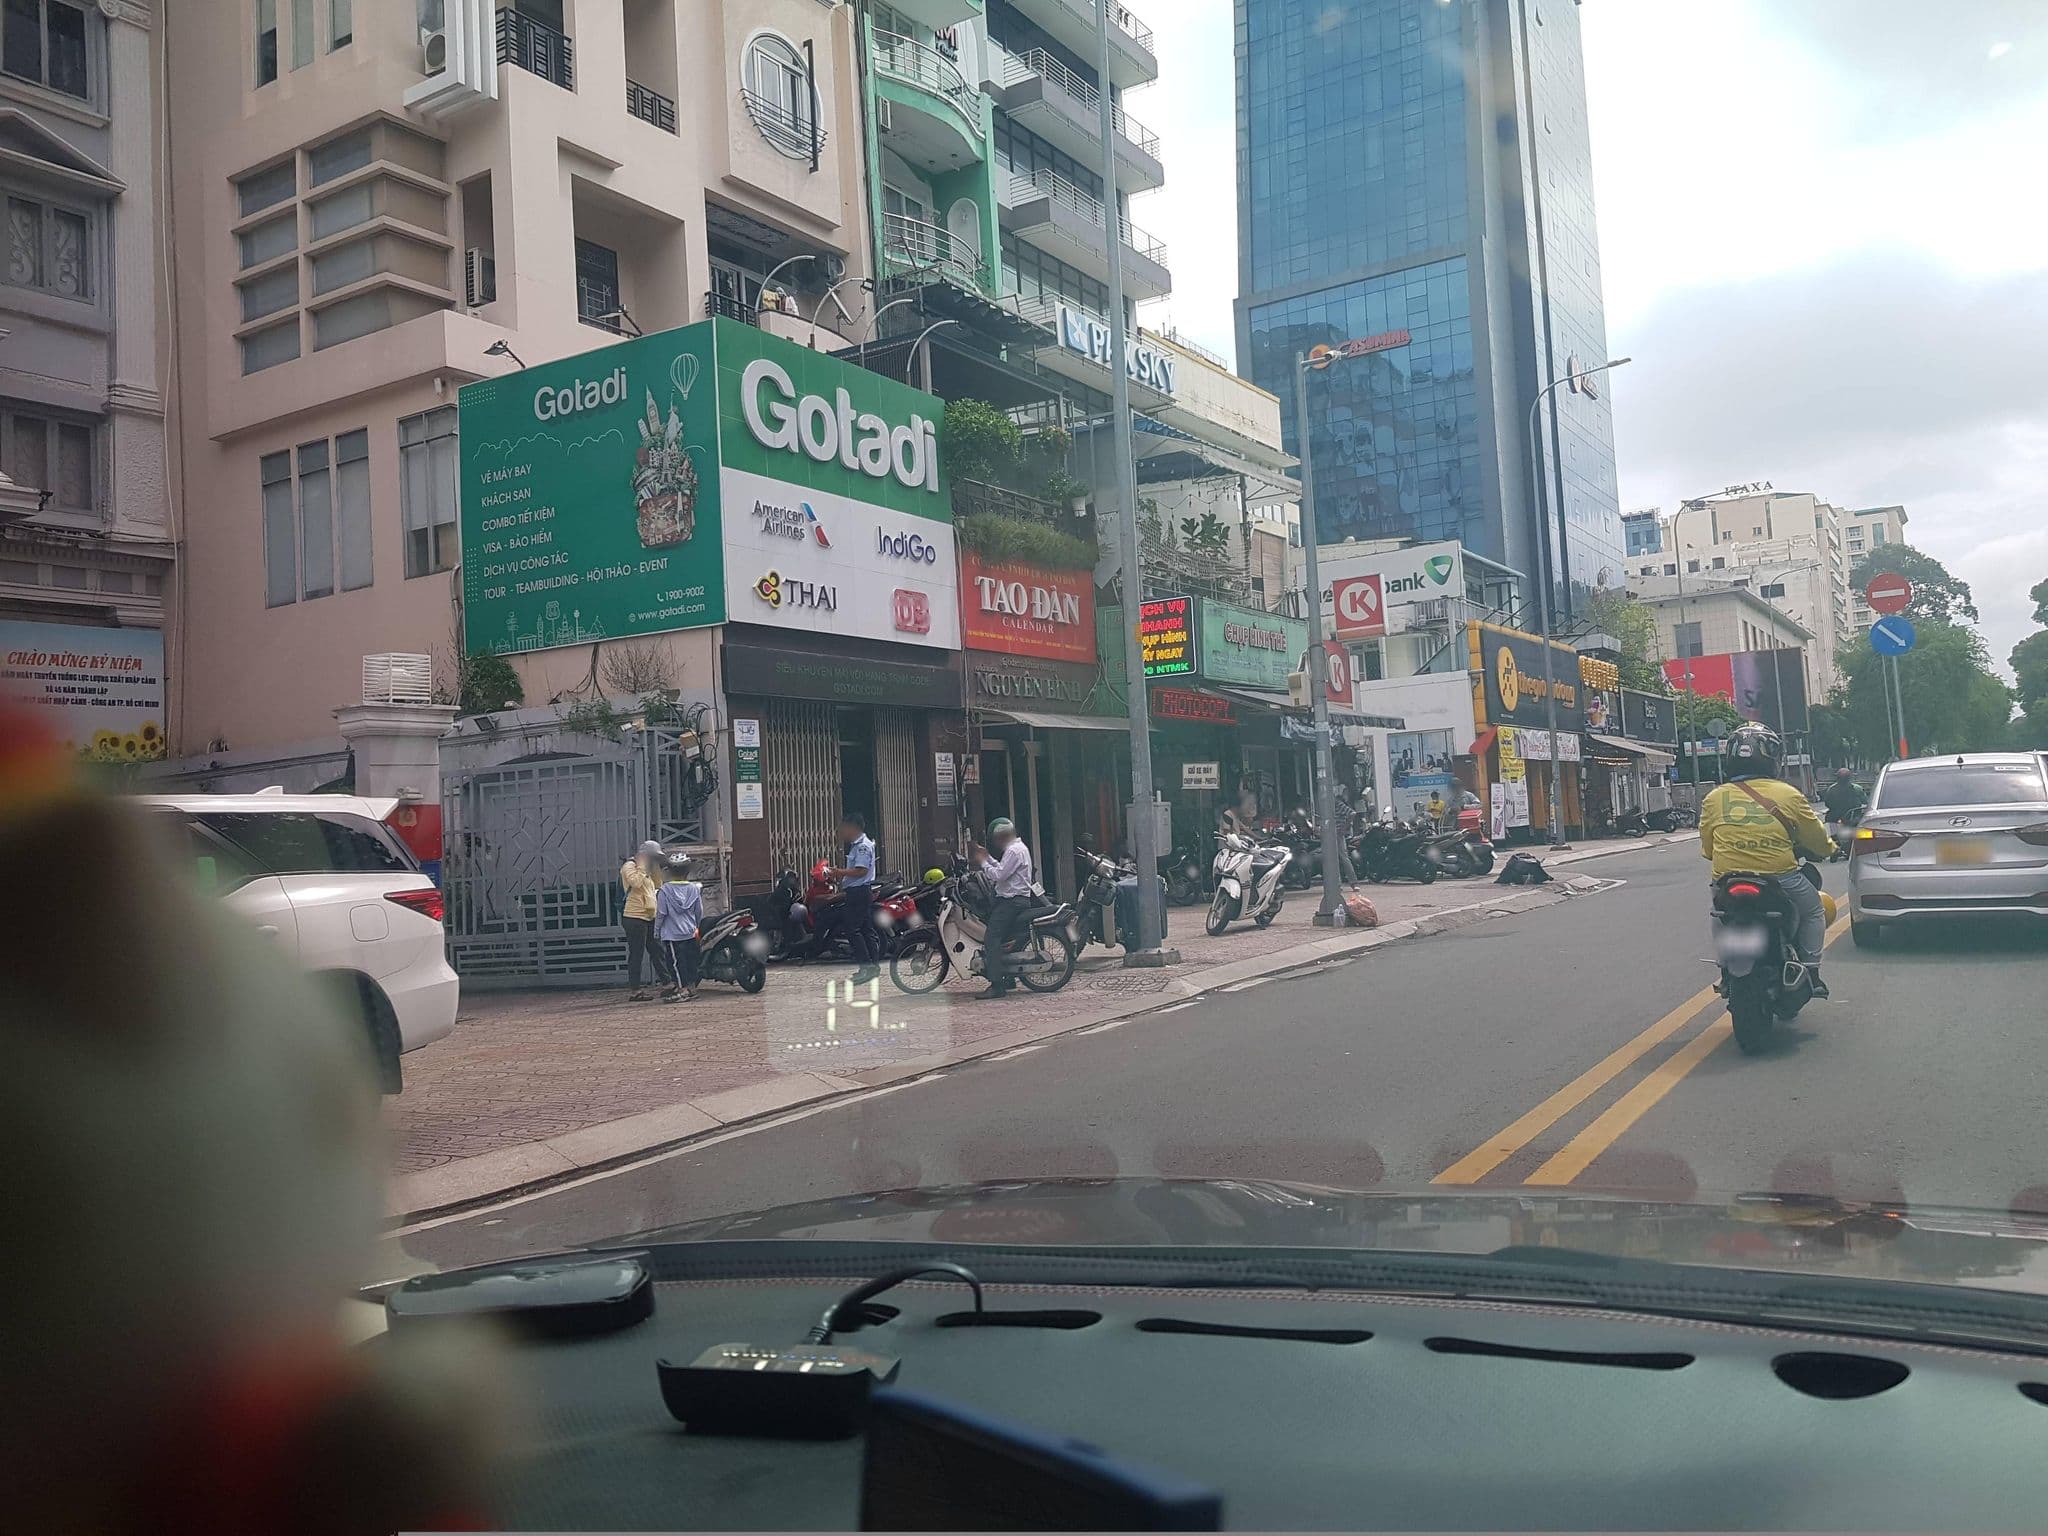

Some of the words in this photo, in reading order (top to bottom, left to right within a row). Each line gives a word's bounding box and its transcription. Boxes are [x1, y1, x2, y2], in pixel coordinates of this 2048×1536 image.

[534, 366, 627, 421] Gotadi
[741, 359, 939, 492] Gotadi
[481, 469, 491, 484] VÉ
[493, 466, 512, 481] MÁY
[514, 464, 531, 477] BAY
[481, 491, 511, 507] KHÁCH
[513, 488, 531, 502] SẠN
[482, 515, 516, 531] COMBO
[518, 507, 532, 524] TIẾT
[534, 506, 555, 521] KIỆM
[753, 500, 804, 524] American
[762, 518, 805, 540] Airlines
[483, 542, 502, 554] VISA
[509, 534, 528, 549] BẢO
[877, 525, 936, 563] IndiGo
[483, 565, 505, 579] DỊCH
[507, 562, 519, 575] VỤ
[520, 555, 549, 571] CÔNG
[551, 550, 568, 565] TÁC
[484, 587, 506, 600] TOUR
[515, 574, 579, 594] TEAMBUILDING
[586, 567, 604, 583] HỘI
[605, 561, 631, 578] THẢO
[639, 558, 669, 573] EVENT
[665, 586, 705, 601] 1900-9002
[782, 578, 838, 611] THAI
[974, 576, 1028, 615] TAO
[1030, 585, 1080, 625] ĐÀN
[638, 603, 705, 620] www.gotadi.com
[1167, 600, 1186, 614] VỤ
[1002, 616, 1055, 634] CALENDAR
[1225, 622, 1249, 652] CHỤP
[1161, 631, 1187, 644] HÌNH
[7, 649, 47, 666] CHÀO
[110, 655, 142, 674] NIỆM
[1156, 647, 1184, 660] NGAY
[1157, 662, 1189, 674] NTMK
[826, 977, 880, 1032] 14
